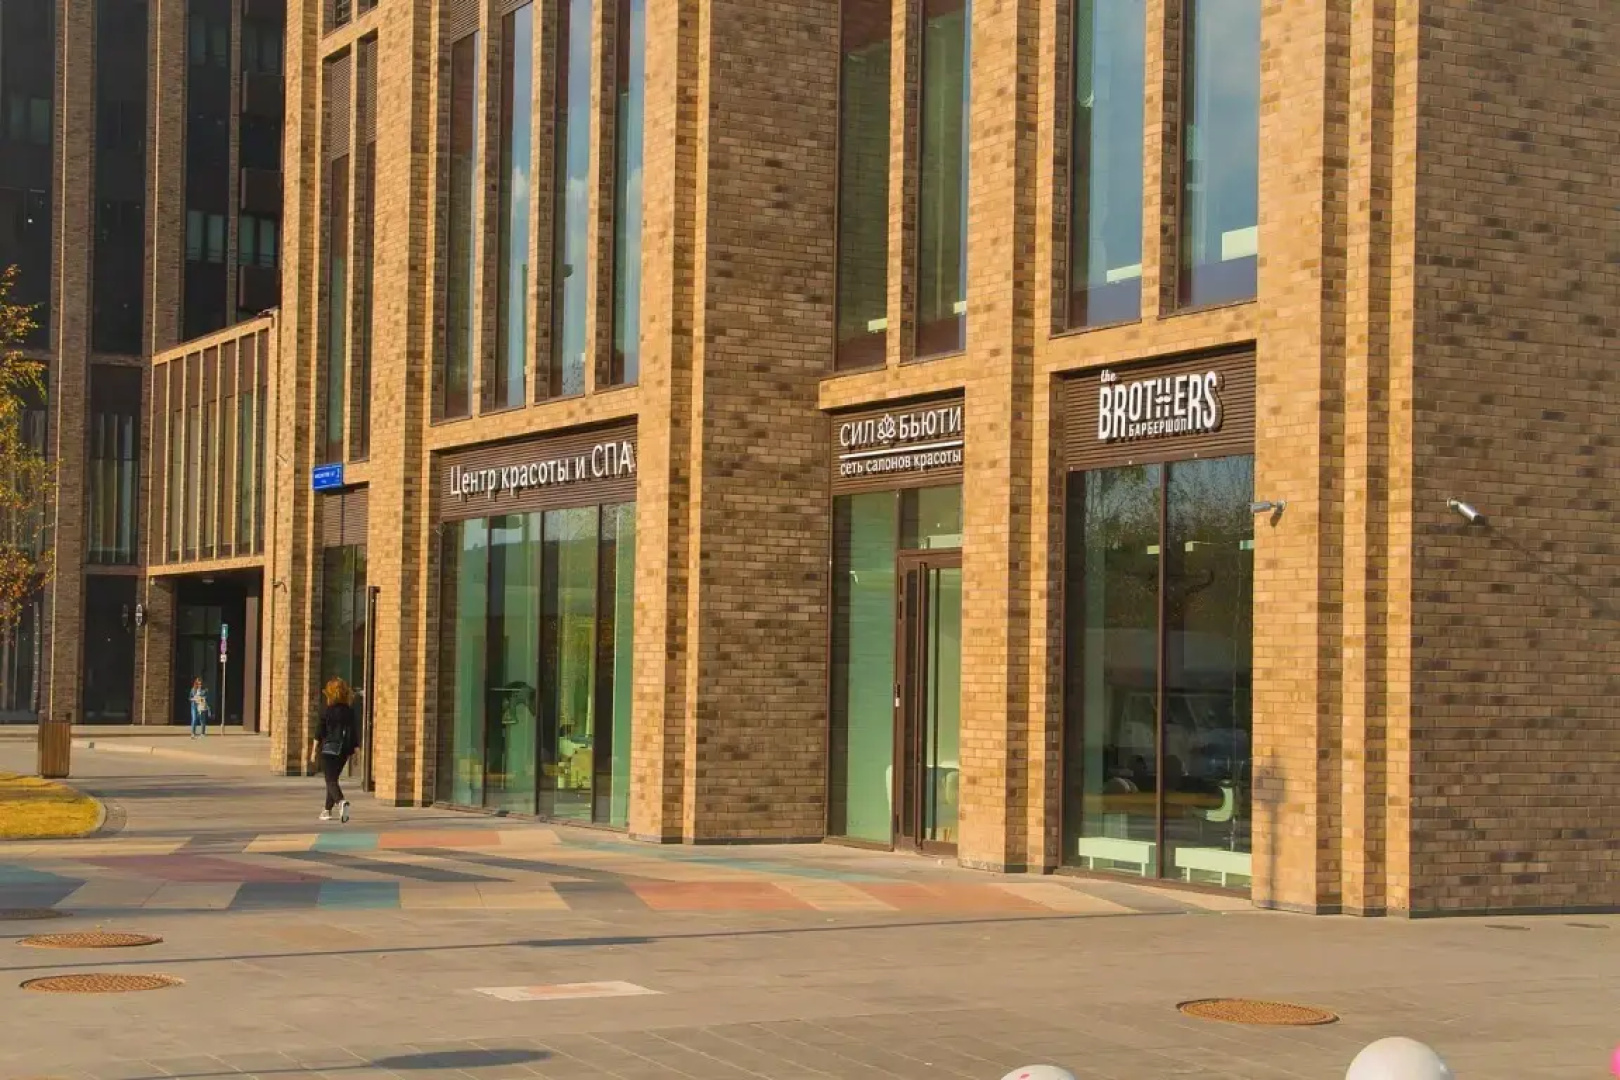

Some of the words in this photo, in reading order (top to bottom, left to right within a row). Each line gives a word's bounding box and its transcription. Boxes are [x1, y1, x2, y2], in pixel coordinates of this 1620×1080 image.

[1100, 369, 1116, 382] the
[1098, 371, 1217, 439] BROTHERS
[840, 419, 875, 446] СИЛ
[899, 406, 962, 440] БЬЮТИ
[1128, 418, 1188, 437] БАРБЕРШОП
[450, 464, 496, 500] Центр
[501, 457, 569, 496] красоты
[574, 457, 586, 479] и
[591, 440, 634, 478] СПА
[840, 462, 863, 476] сеть
[913, 449, 962, 472] красоты
